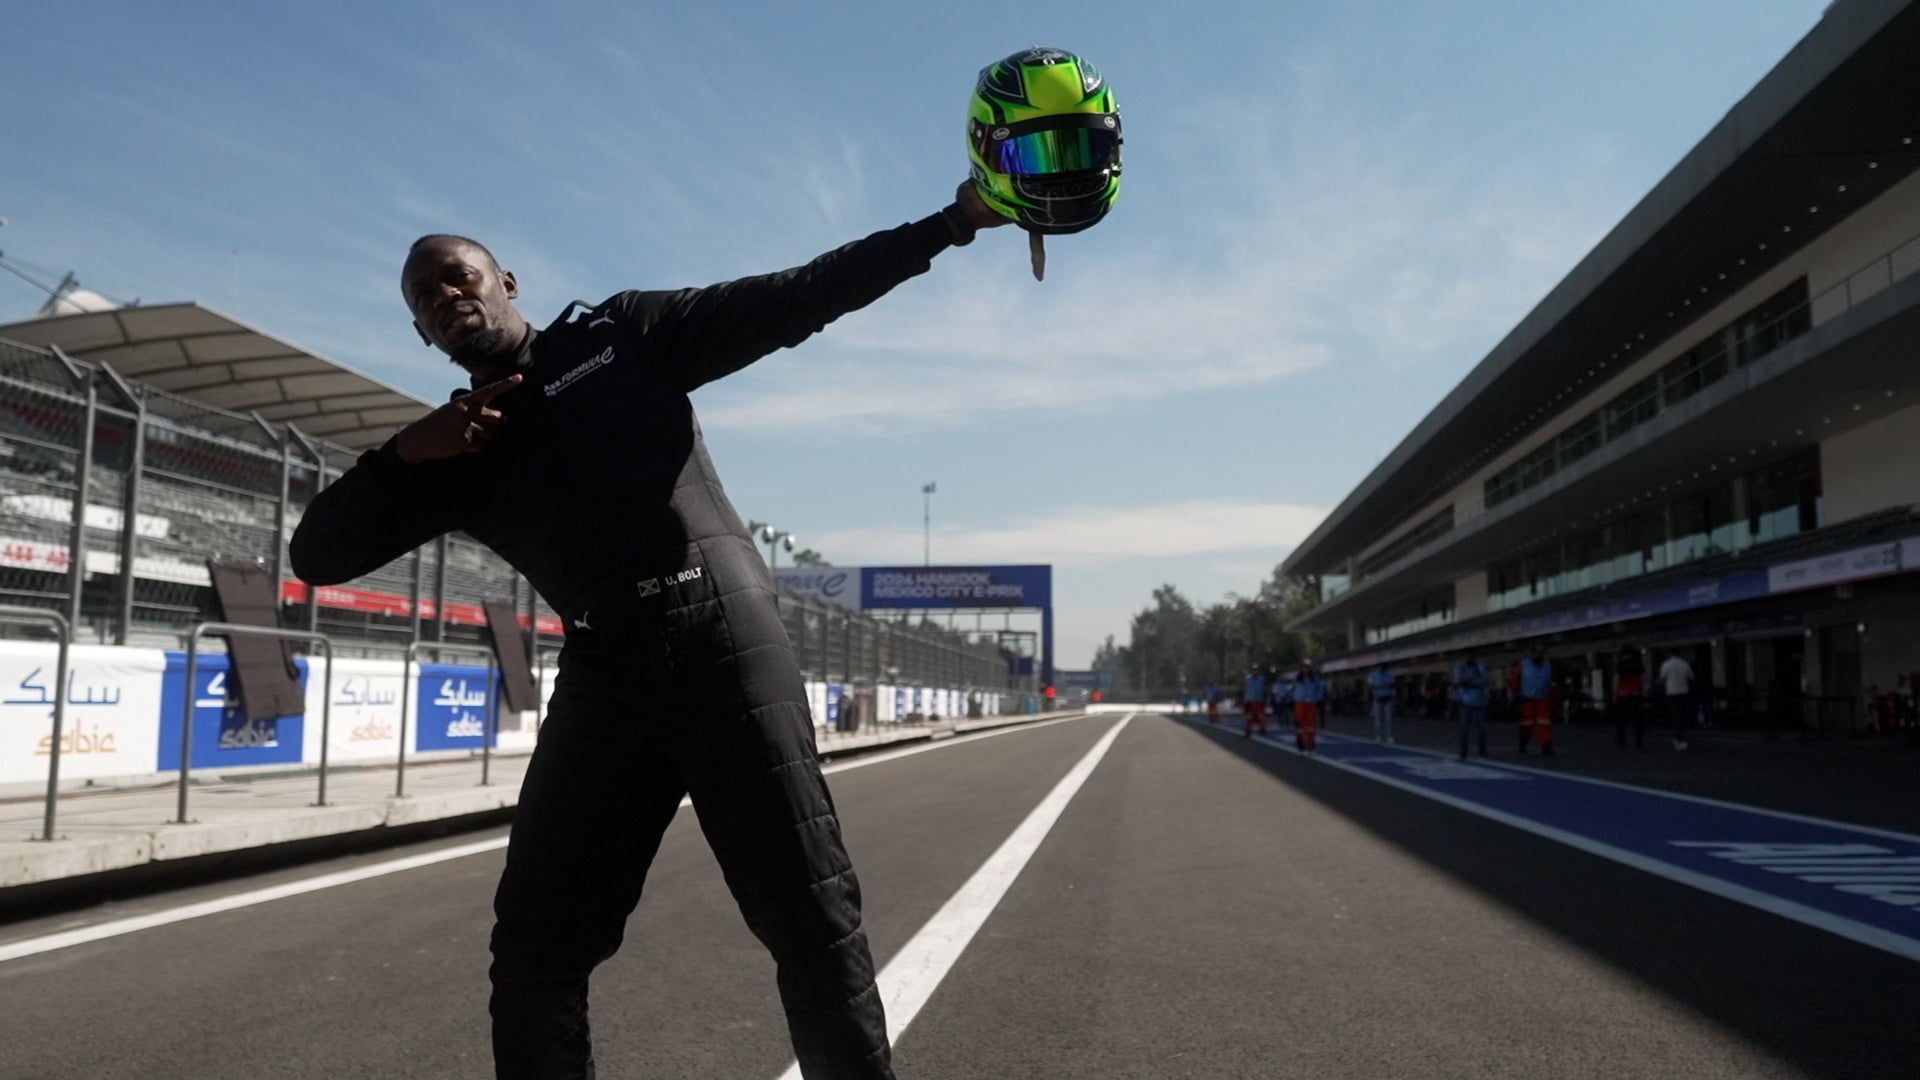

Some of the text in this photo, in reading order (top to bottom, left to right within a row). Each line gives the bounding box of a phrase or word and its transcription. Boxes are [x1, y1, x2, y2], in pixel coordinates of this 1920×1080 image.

[48, 550, 68, 566] AB
[665, 566, 702, 586] U. BOLT
[916, 573, 990, 586] HANKOOK
[873, 586, 934, 598] MEXICO
[936, 586, 972, 598] CITY
[35, 718, 116, 755] sabic
